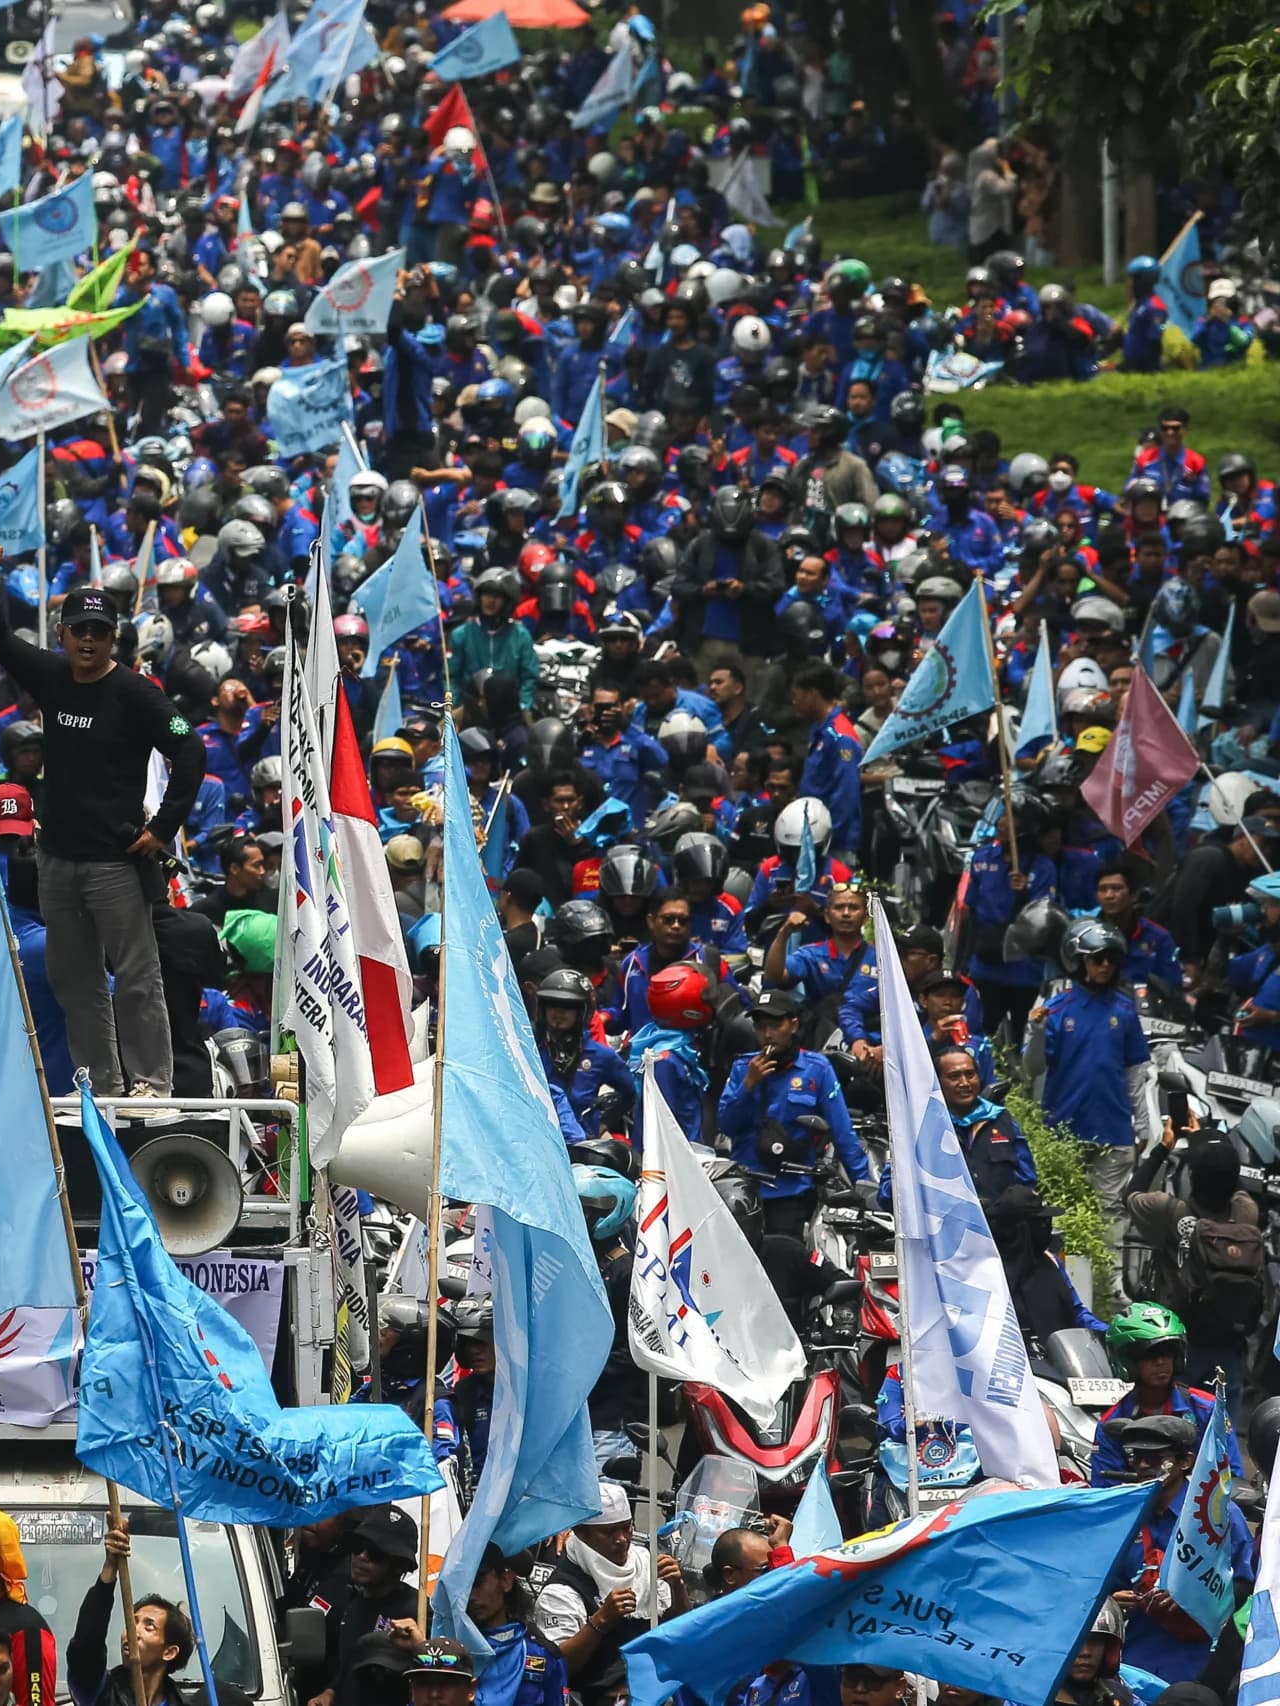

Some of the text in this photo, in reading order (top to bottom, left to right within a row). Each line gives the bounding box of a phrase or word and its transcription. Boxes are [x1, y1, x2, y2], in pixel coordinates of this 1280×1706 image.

[57, 711, 94, 729] KBPBI
[184, 1262, 269, 1293] DONESIA
[1072, 1381, 1086, 1392] BE
[1088, 1381, 1116, 1393] 2592
[210, 1454, 337, 1504] INDONESIA
[21, 1523, 86, 1540] PRODUCTION
[29, 1672, 41, 1706] BAR
